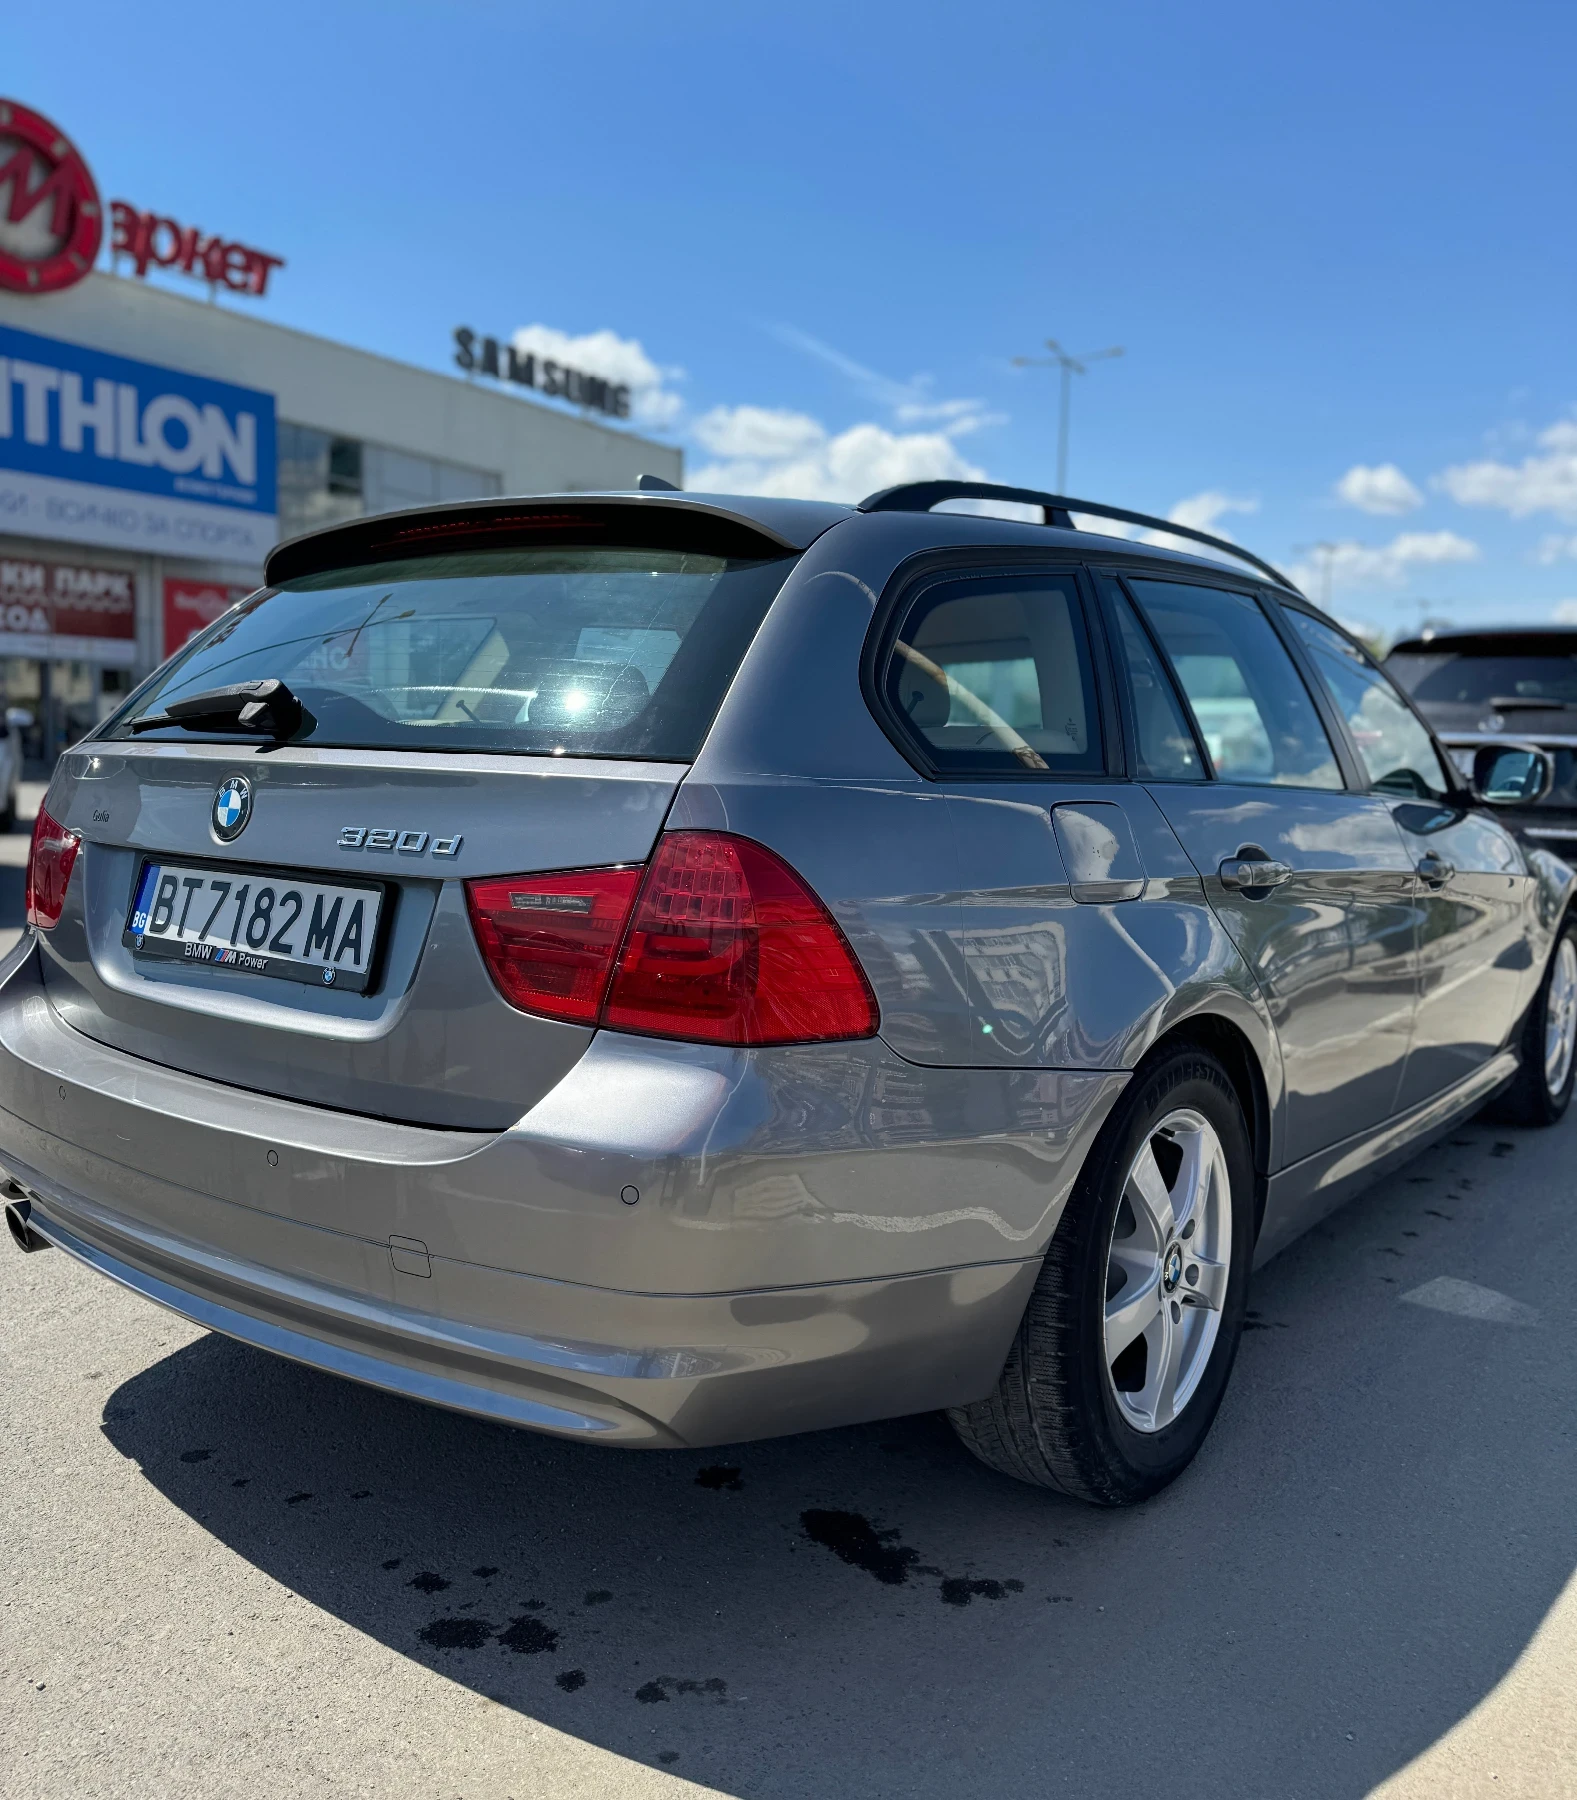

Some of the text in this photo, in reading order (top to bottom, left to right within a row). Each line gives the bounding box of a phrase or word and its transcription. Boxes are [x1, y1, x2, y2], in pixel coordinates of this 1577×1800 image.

[453, 326, 631, 420] SAMSUNG
[218, 779, 249, 800] BMW
[132, 910, 147, 928] BG
[184, 942, 212, 960] BMW
[238, 953, 268, 970] Power
